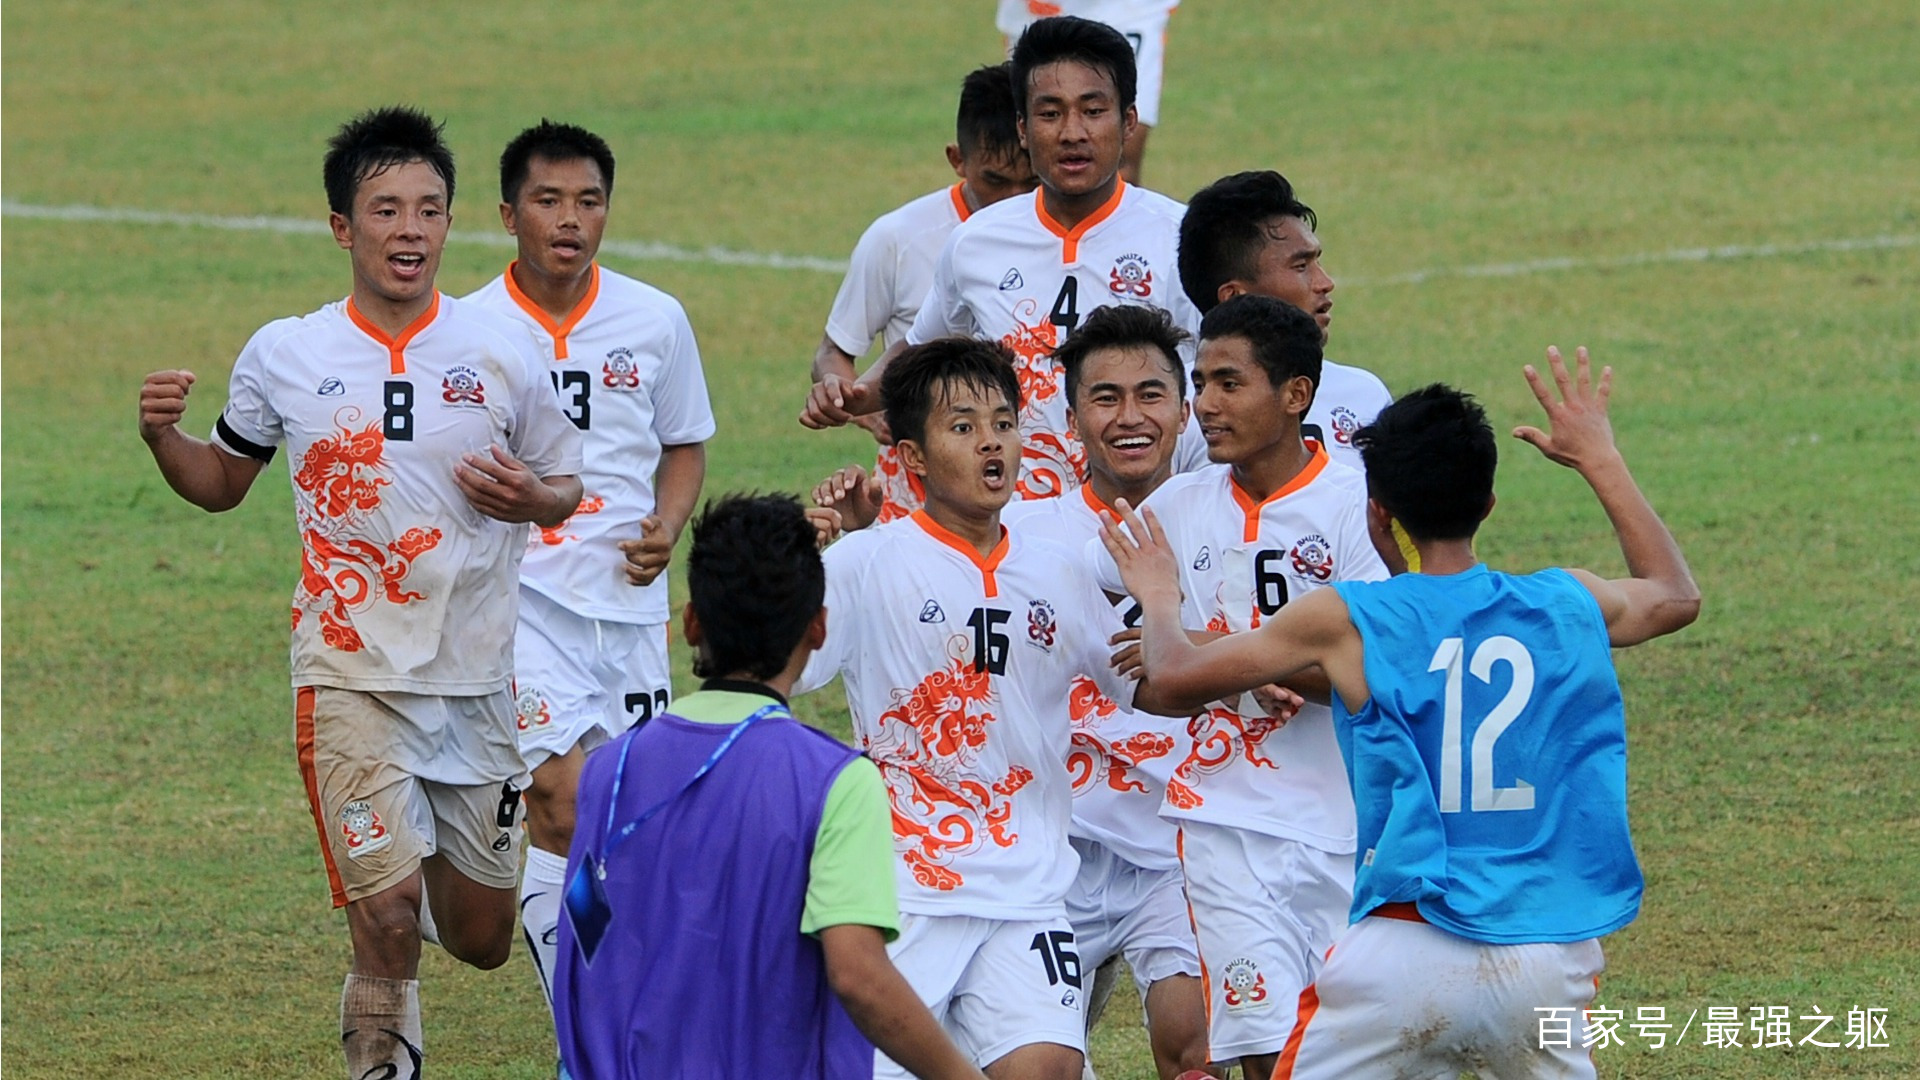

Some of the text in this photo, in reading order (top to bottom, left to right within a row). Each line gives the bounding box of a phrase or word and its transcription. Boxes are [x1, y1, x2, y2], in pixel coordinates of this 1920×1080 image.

[1115, 253, 1149, 267] BHUTAN
[1049, 275, 1080, 339] 4
[383, 381, 414, 441] 8
[550, 370, 591, 430] 3
[1296, 534, 1331, 550] BHUTAN
[1255, 549, 1289, 616] 6
[966, 607, 1012, 676] 16
[1427, 635, 1536, 813] 12
[1029, 930, 1082, 991] 16
[1225, 958, 1257, 974] BHUTAN
